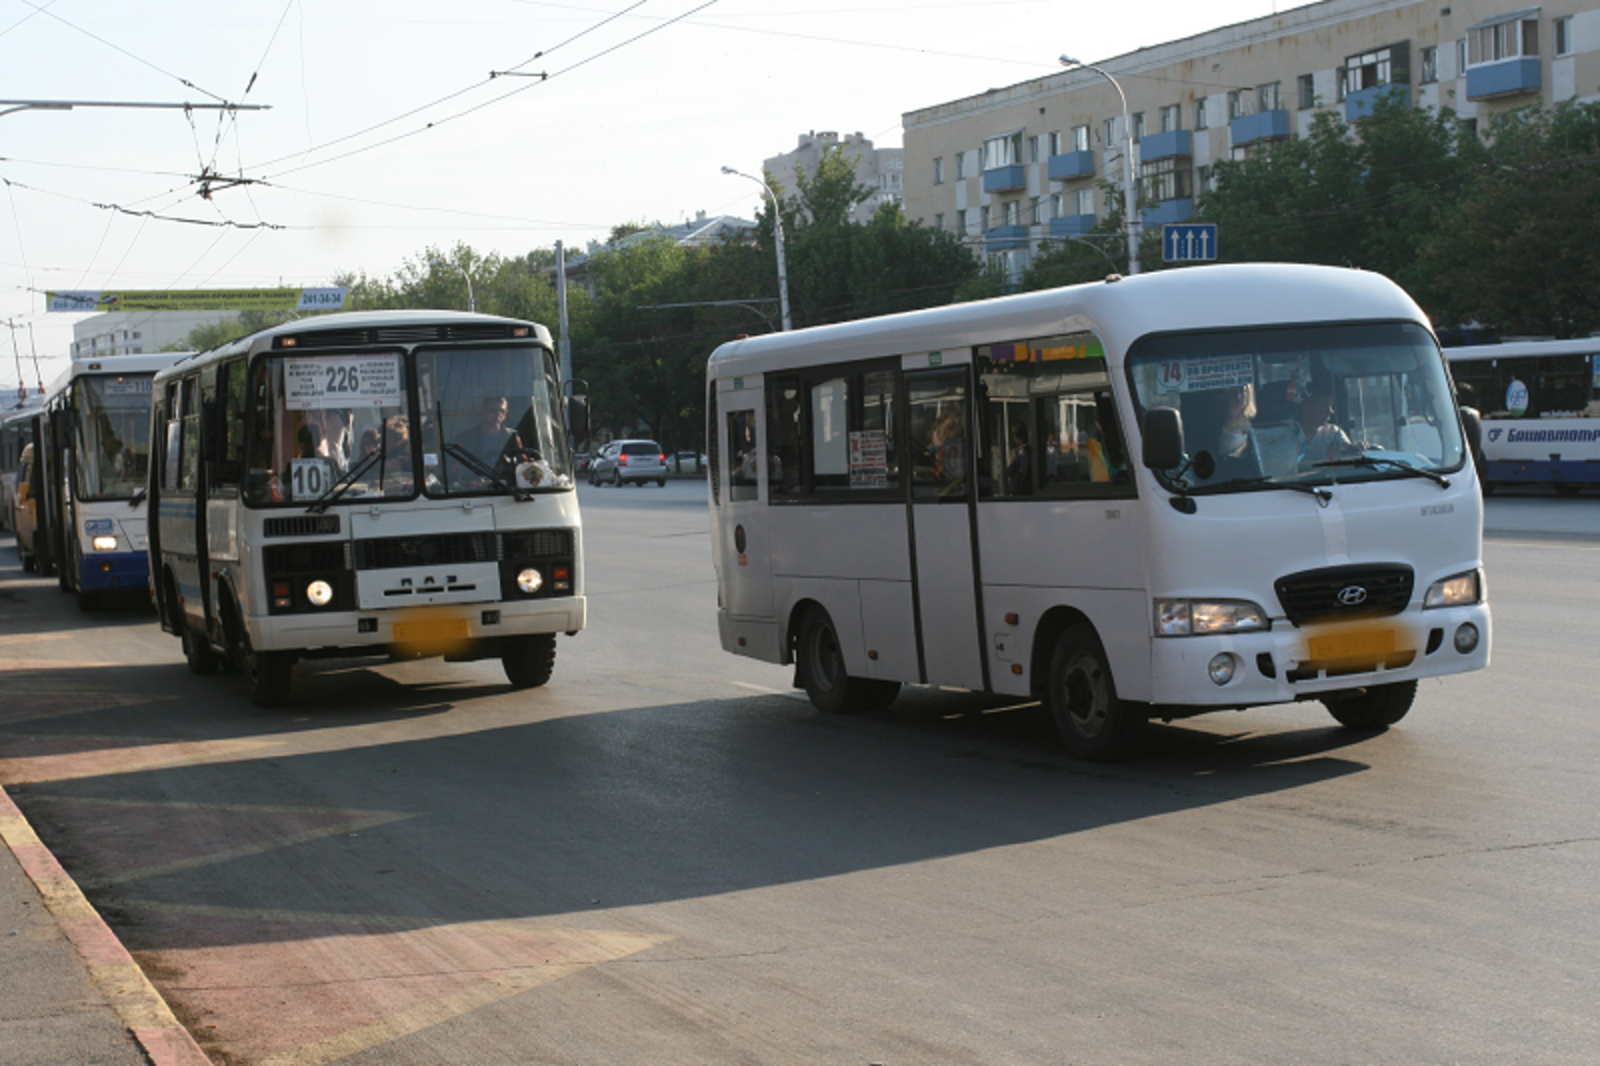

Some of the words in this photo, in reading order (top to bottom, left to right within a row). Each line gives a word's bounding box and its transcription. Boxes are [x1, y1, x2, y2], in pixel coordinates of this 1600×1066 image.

[302, 293, 342, 305] 241-34-34
[326, 366, 359, 393] 226
[1161, 361, 1182, 383] 74
[293, 465, 321, 495] 10
